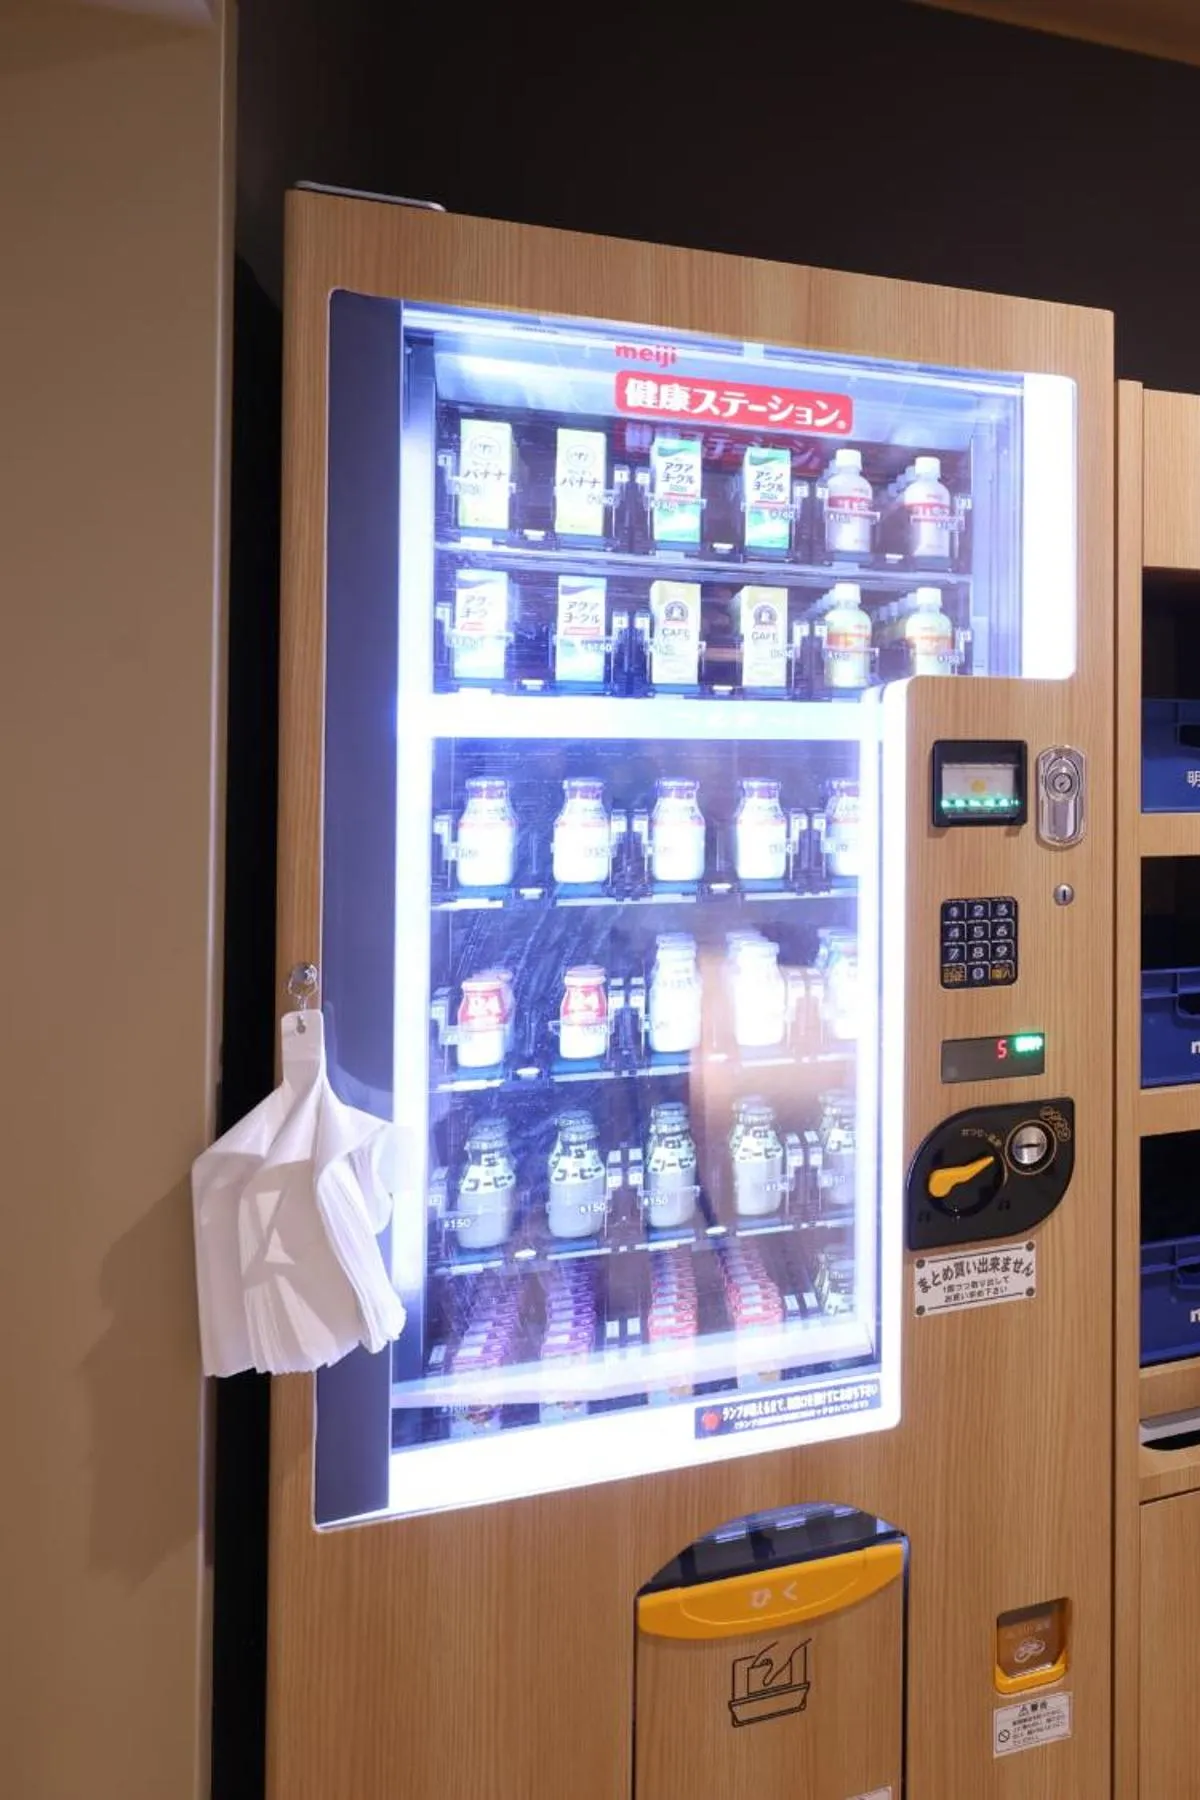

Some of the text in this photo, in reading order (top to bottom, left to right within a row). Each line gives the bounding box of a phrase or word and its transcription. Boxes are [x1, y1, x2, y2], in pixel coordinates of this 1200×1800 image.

[615, 344, 676, 368] meiji
[950, 906, 958, 918] 1
[974, 904, 984, 917] 2
[997, 903, 1008, 917] 3
[948, 927, 959, 939] 4
[973, 926, 984, 938] 5
[996, 925, 1007, 937] 6
[949, 948, 959, 961] 7
[973, 947, 984, 959] 8
[997, 945, 1007, 957] 9
[972, 967, 984, 980] 0
[997, 1039, 1008, 1060] 5
[918, 1256, 1034, 1293] まとめ買い出来ません
